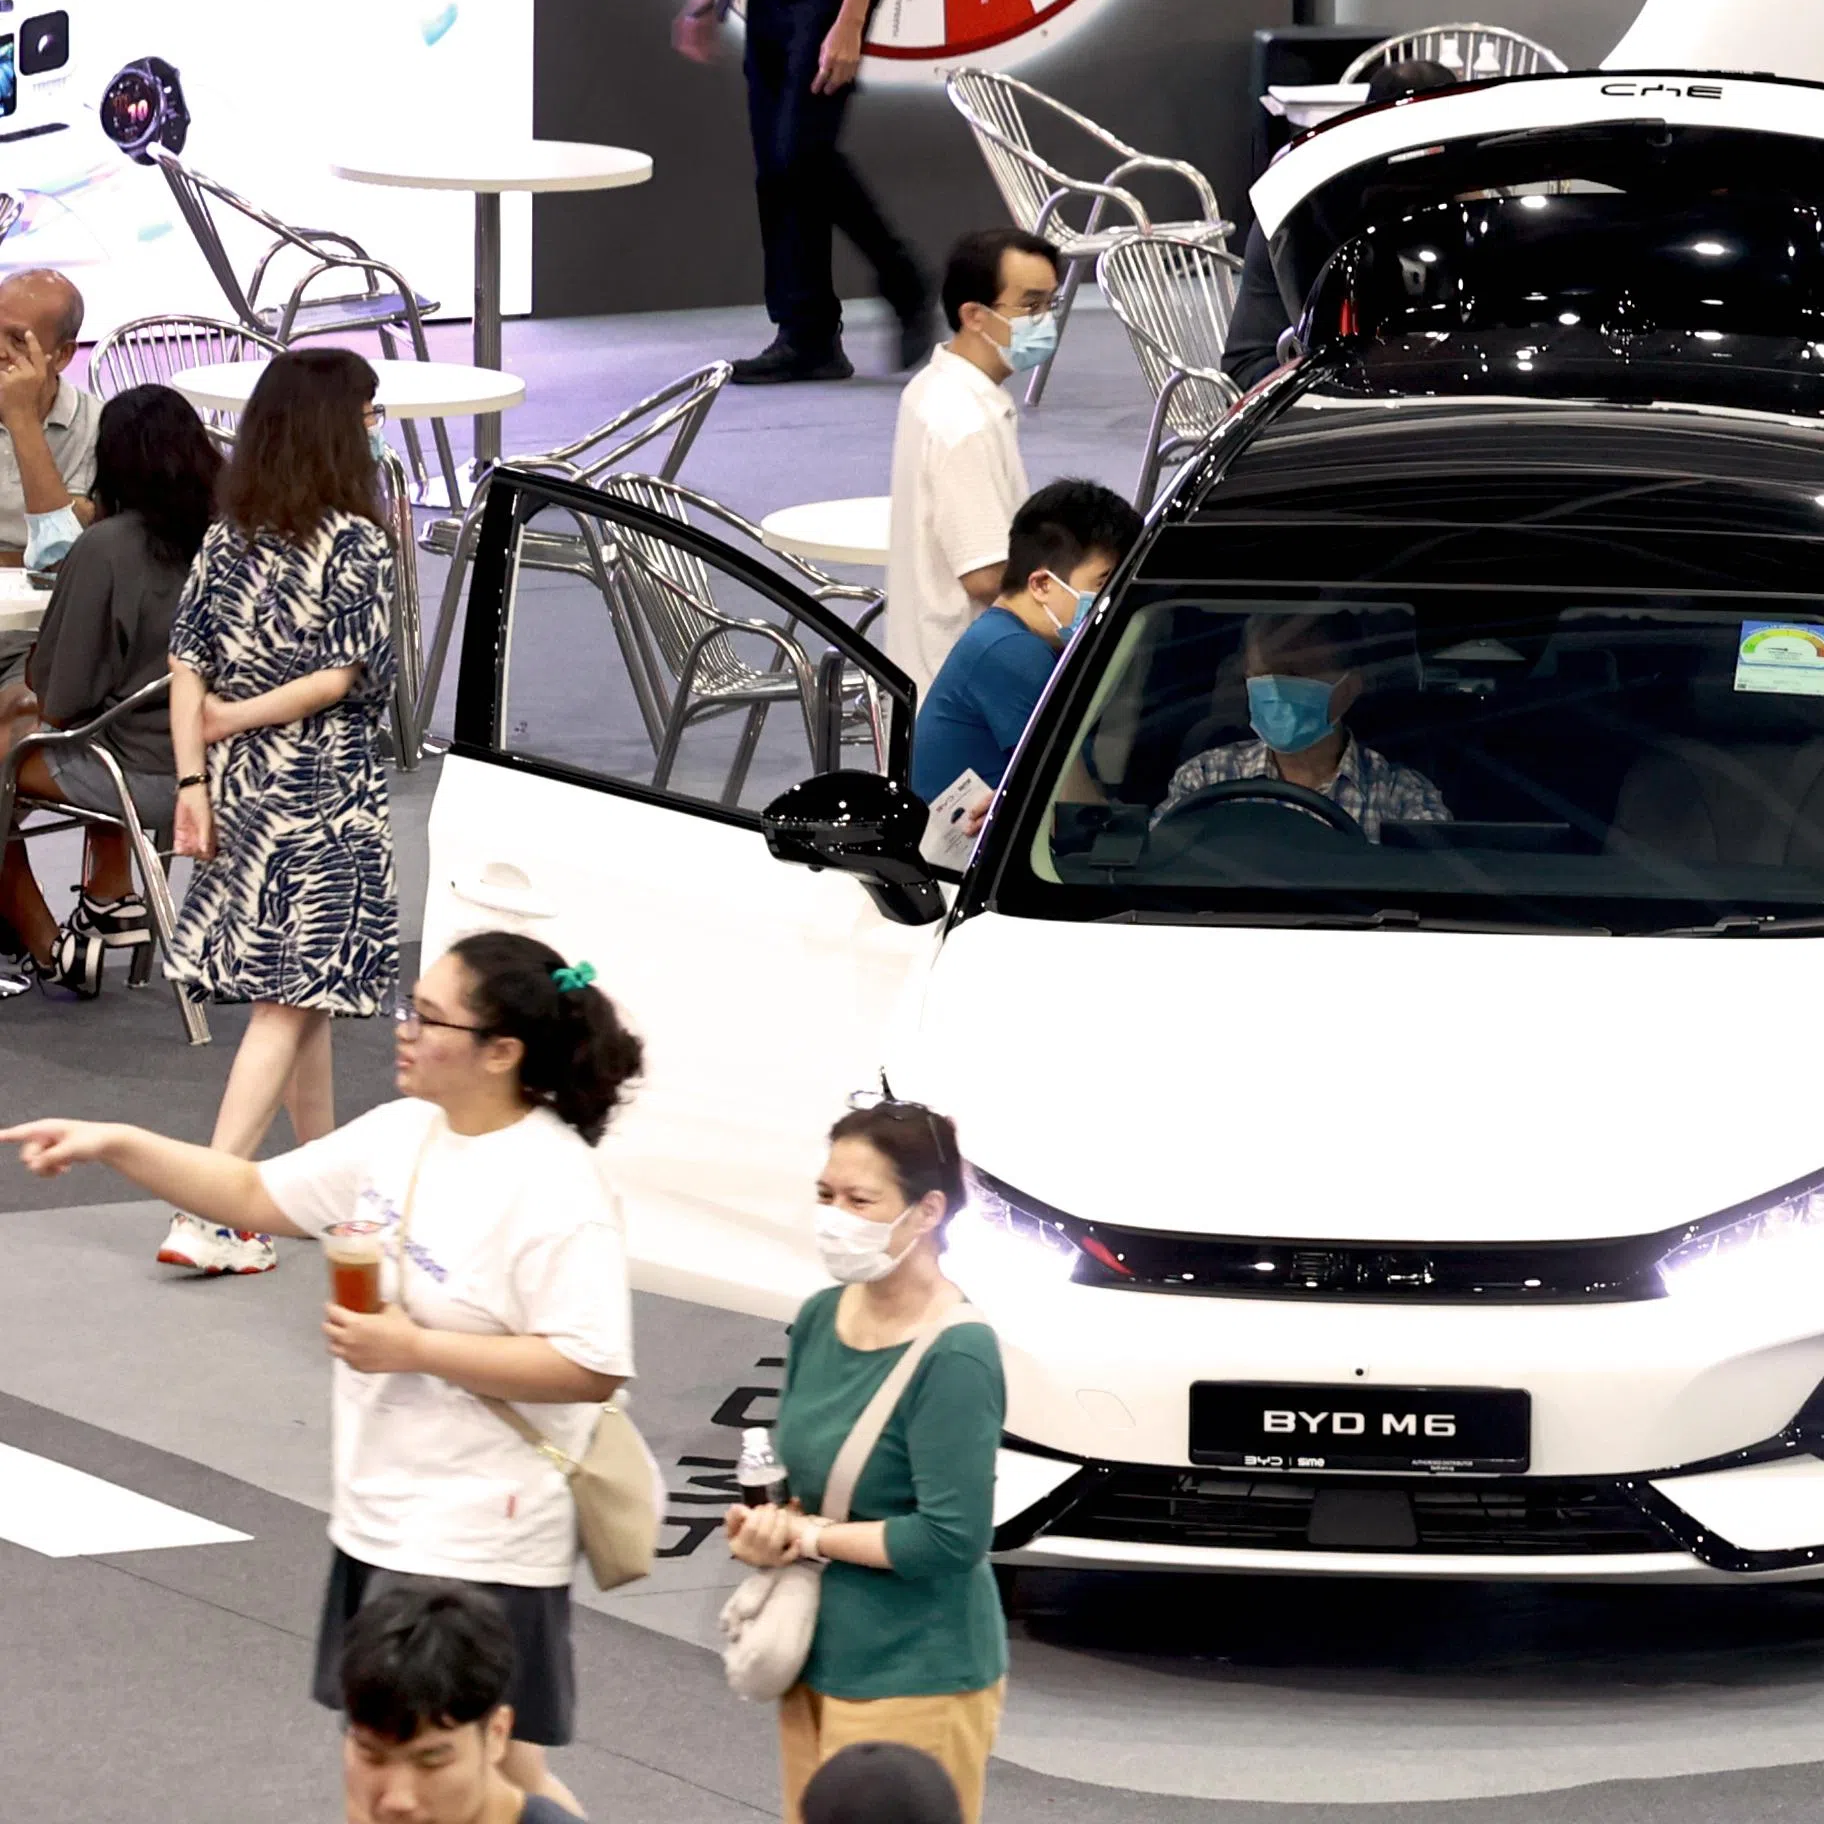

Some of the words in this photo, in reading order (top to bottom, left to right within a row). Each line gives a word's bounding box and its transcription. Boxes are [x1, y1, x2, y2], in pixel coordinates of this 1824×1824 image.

[1263, 1410, 1366, 1436] BYD
[1381, 1412, 1457, 1437] M6
[1244, 1455, 1283, 1467] BYD
[1297, 1456, 1326, 1468] sime
